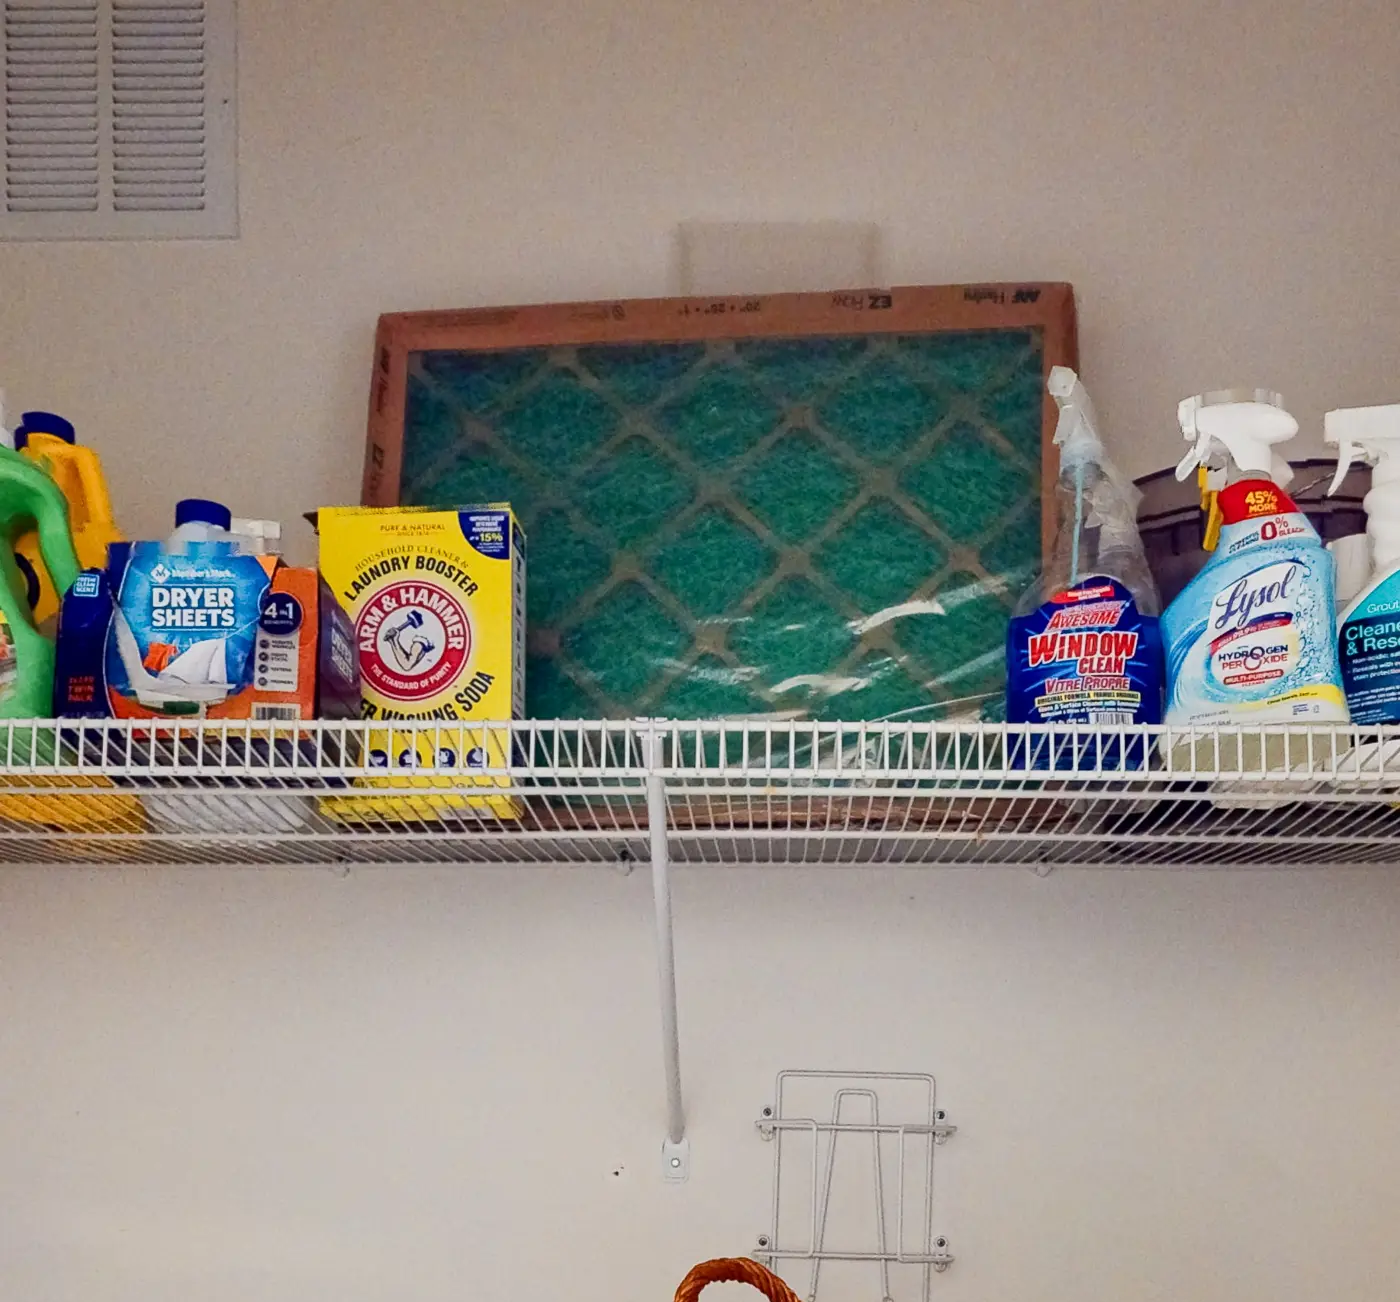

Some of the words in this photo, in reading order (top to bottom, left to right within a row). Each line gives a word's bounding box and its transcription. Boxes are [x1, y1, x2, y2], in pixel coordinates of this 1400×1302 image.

[868, 296, 892, 309] EZ
[1245, 491, 1278, 504] 45%
[1249, 502, 1277, 513] MORE
[480, 532, 503, 542] 15%
[355, 545, 414, 571] HOUSEHOLD
[417, 545, 461, 562] CLEANER
[344, 556, 410, 601] LAUNDRY
[415, 555, 479, 597] BOOSTER
[152, 587, 234, 607] DRYER
[1215, 565, 1297, 629] Lysol
[152, 608, 235, 627] SHEETS
[264, 602, 278, 619] 4
[285, 602, 294, 619] 1
[360, 605, 385, 652] ARM
[381, 594, 399, 612] &
[400, 587, 465, 650] HAMMER
[1048, 610, 1120, 630] AWESOME
[1029, 632, 1137, 666] WINDOW
[1219, 645, 1288, 662] HYDROGEN
[1346, 641, 1359, 656] &
[1363, 637, 1400, 652] Res
[1078, 657, 1124, 674] CLEAN
[1222, 653, 1289, 671] PEROXIDE
[381, 674, 419, 690] STANDARD
[420, 680, 429, 689] OF
[429, 661, 452, 684] PURITY
[1046, 678, 1081, 693] VITRE
[1084, 676, 1129, 689] PROPRE
[1225, 670, 1282, 684] MULTI-PURPOSE
[455, 671, 495, 712] SODA
